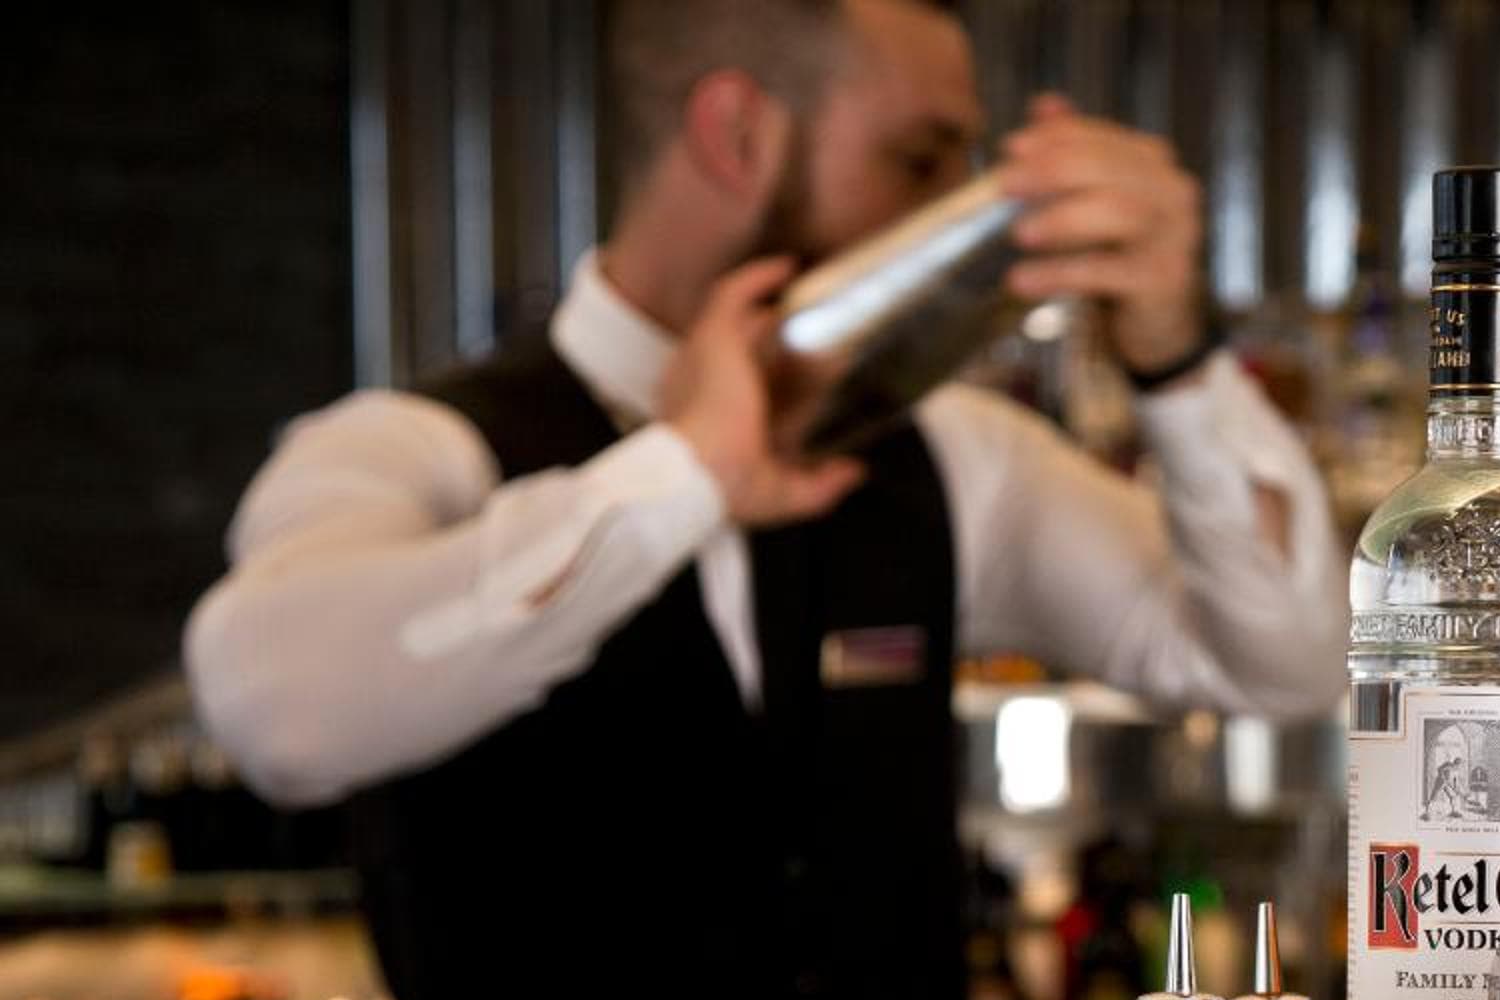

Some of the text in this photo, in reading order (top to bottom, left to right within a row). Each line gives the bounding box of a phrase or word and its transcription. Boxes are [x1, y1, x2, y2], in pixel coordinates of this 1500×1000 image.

[1397, 612, 1489, 640] FAMILY
[1369, 849, 1489, 943] Ketel
[1396, 970, 1476, 990] FAMILY
